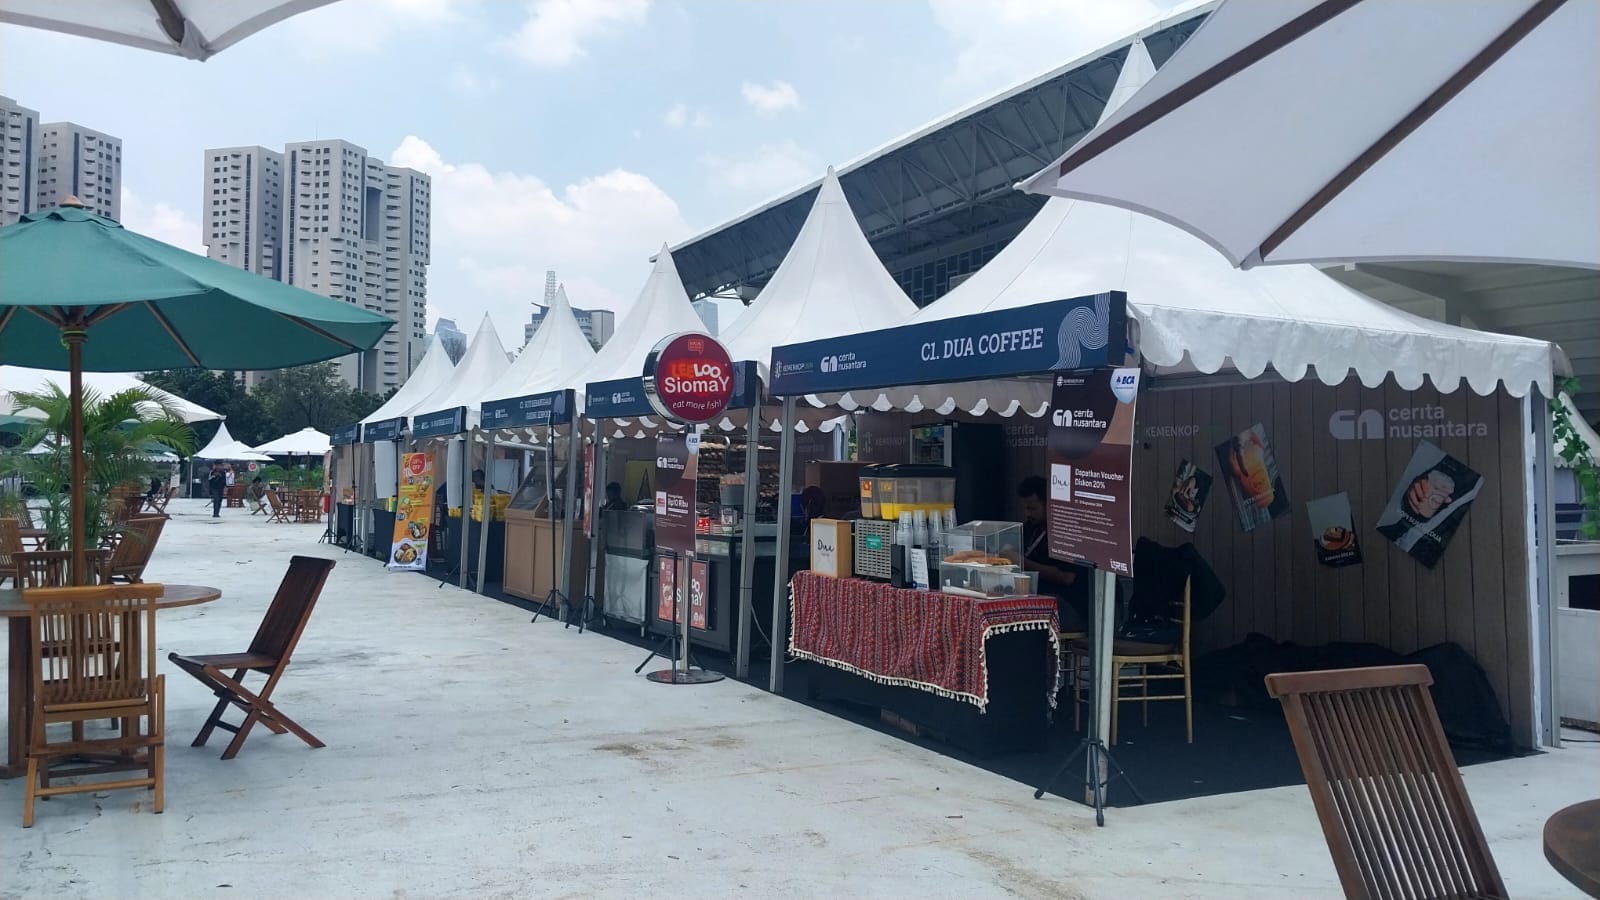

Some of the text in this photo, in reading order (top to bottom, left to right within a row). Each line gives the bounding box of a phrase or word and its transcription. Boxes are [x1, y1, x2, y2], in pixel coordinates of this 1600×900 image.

[921, 328, 1044, 361] C1. DUA COFFEE
[839, 352, 856, 362] cerita
[838, 360, 867, 371] nusantara
[664, 375, 730, 394] SiomaY
[1122, 375, 1135, 385] BCA
[672, 401, 685, 409] eat
[685, 401, 705, 410] more
[1074, 408, 1094, 419] cerita
[1388, 403, 1445, 420] cerita
[1073, 417, 1107, 429] nusantara
[1389, 420, 1488, 438] nusantara
[1075, 468, 1124, 481] Dapatkan Voucher
[1075, 478, 1105, 489] Diskon 20%
